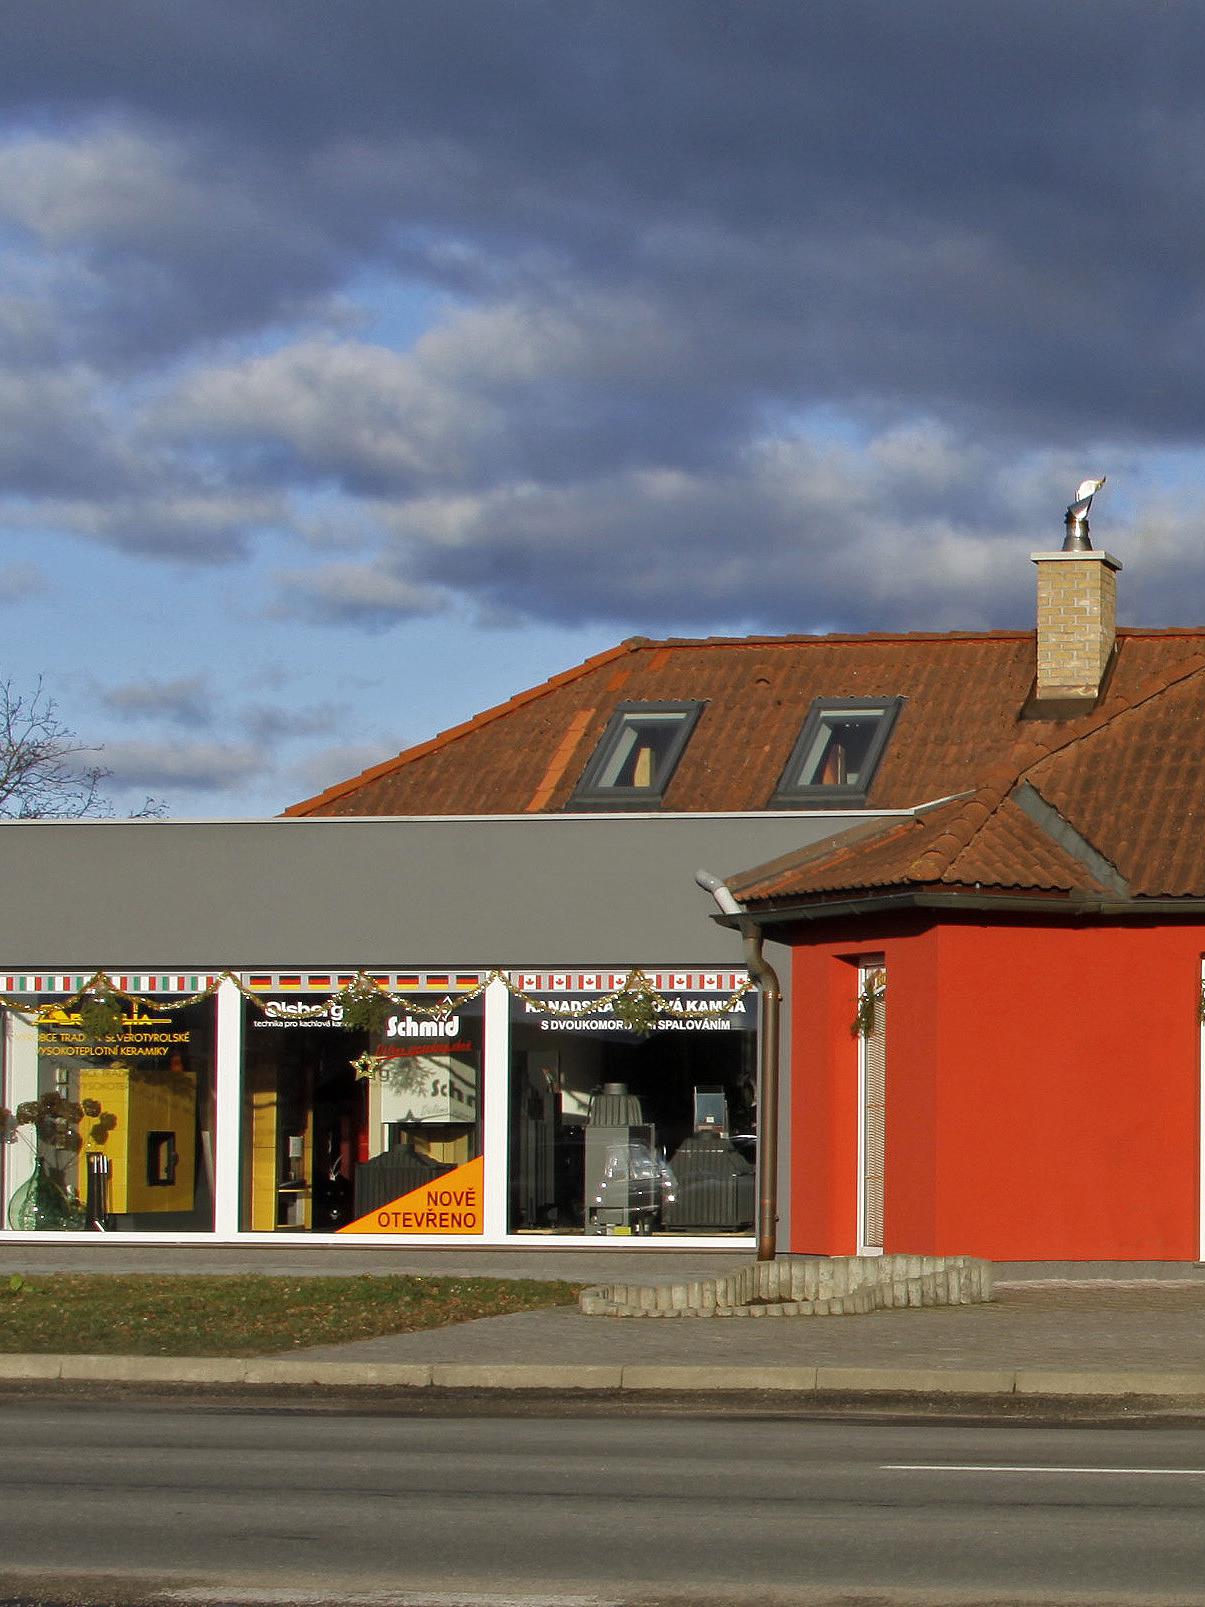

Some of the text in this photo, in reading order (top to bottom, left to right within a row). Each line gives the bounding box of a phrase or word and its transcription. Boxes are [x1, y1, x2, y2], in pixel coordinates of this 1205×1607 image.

[254, 1020, 283, 1028] technika
[284, 1021, 298, 1029] pro
[387, 1014, 458, 1037] Schmid
[541, 1020, 549, 1030] S
[658, 1018, 731, 1030] SPALOVÁNÍM
[120, 1046, 169, 1056] KERAMIKY
[427, 1187, 476, 1207] NOVĚ
[378, 1208, 476, 1228] OTEVŘENO
